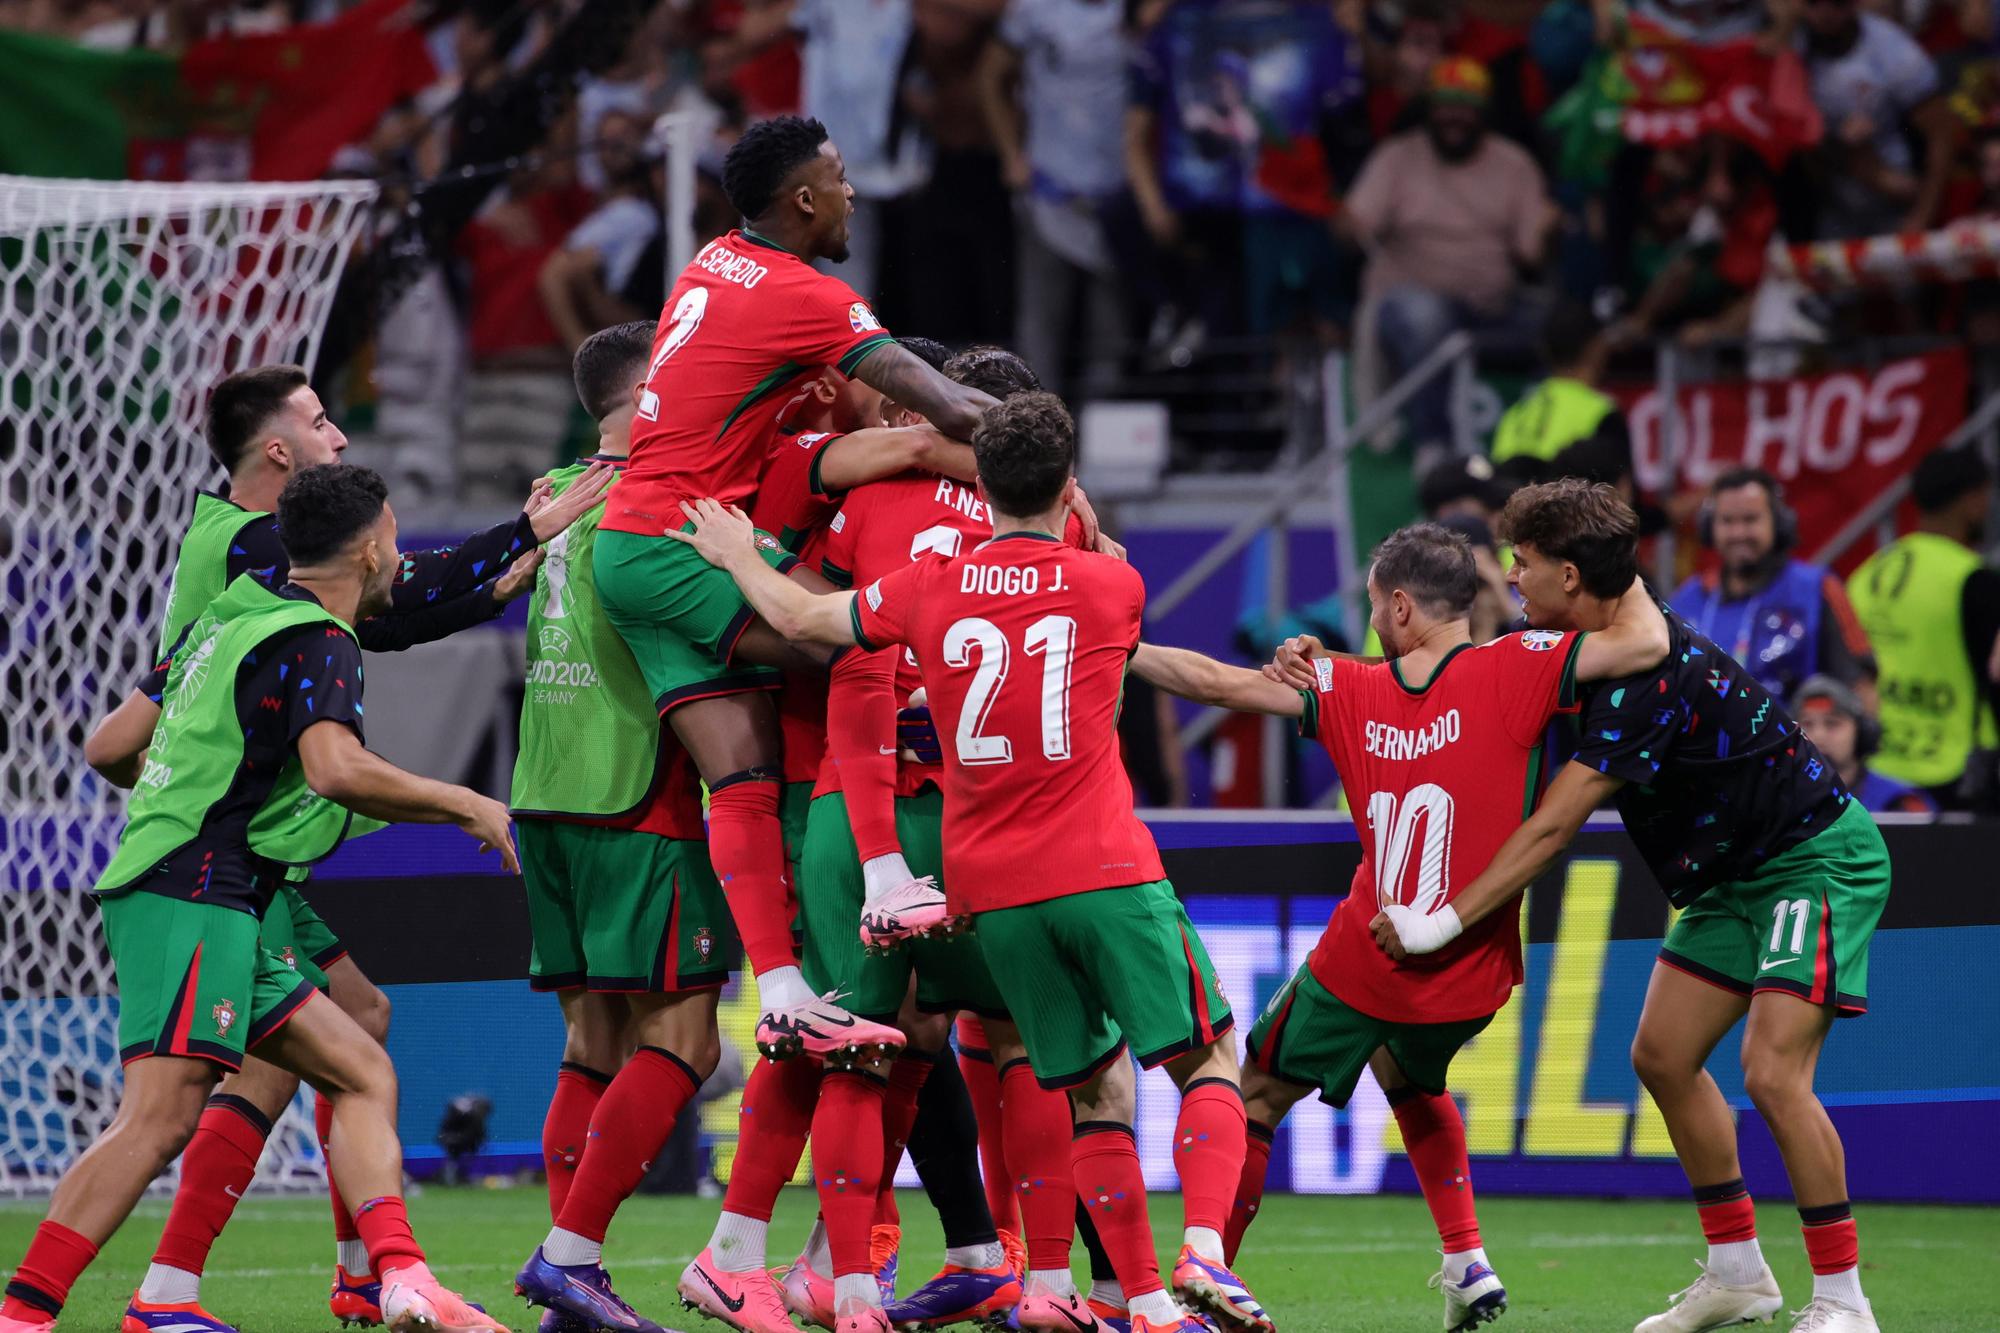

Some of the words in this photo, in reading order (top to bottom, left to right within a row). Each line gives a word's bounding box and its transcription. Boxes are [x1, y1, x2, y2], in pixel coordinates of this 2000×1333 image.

[1628, 357, 1926, 492] OLHOS
[960, 563, 1039, 596] DIOGO
[1046, 564, 1069, 592] J.
[942, 614, 1077, 766] 21
[1367, 782, 1455, 913] 10
[1769, 898, 1810, 955] 11
